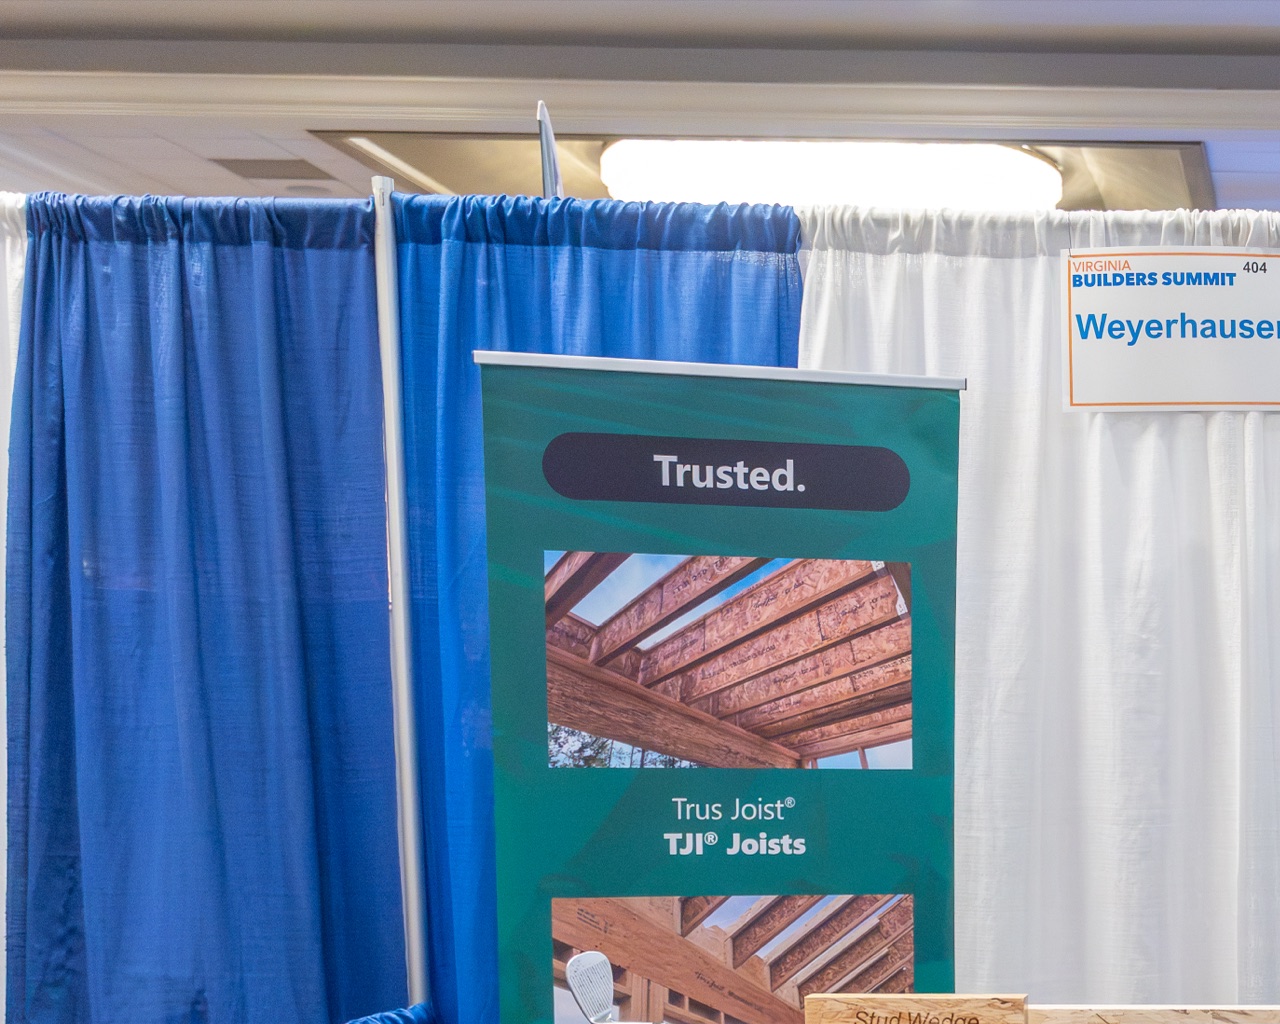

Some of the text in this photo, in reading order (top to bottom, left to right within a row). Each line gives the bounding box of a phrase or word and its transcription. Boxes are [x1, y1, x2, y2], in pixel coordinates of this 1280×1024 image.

[1072, 260, 1131, 272] VIRGINIA
[1243, 261, 1267, 274] 404
[1072, 272, 1237, 288] BUILDERS SUMMIT
[653, 453, 807, 493] Trusted.
[671, 796, 722, 822] Trus
[727, 832, 807, 857] Joists
